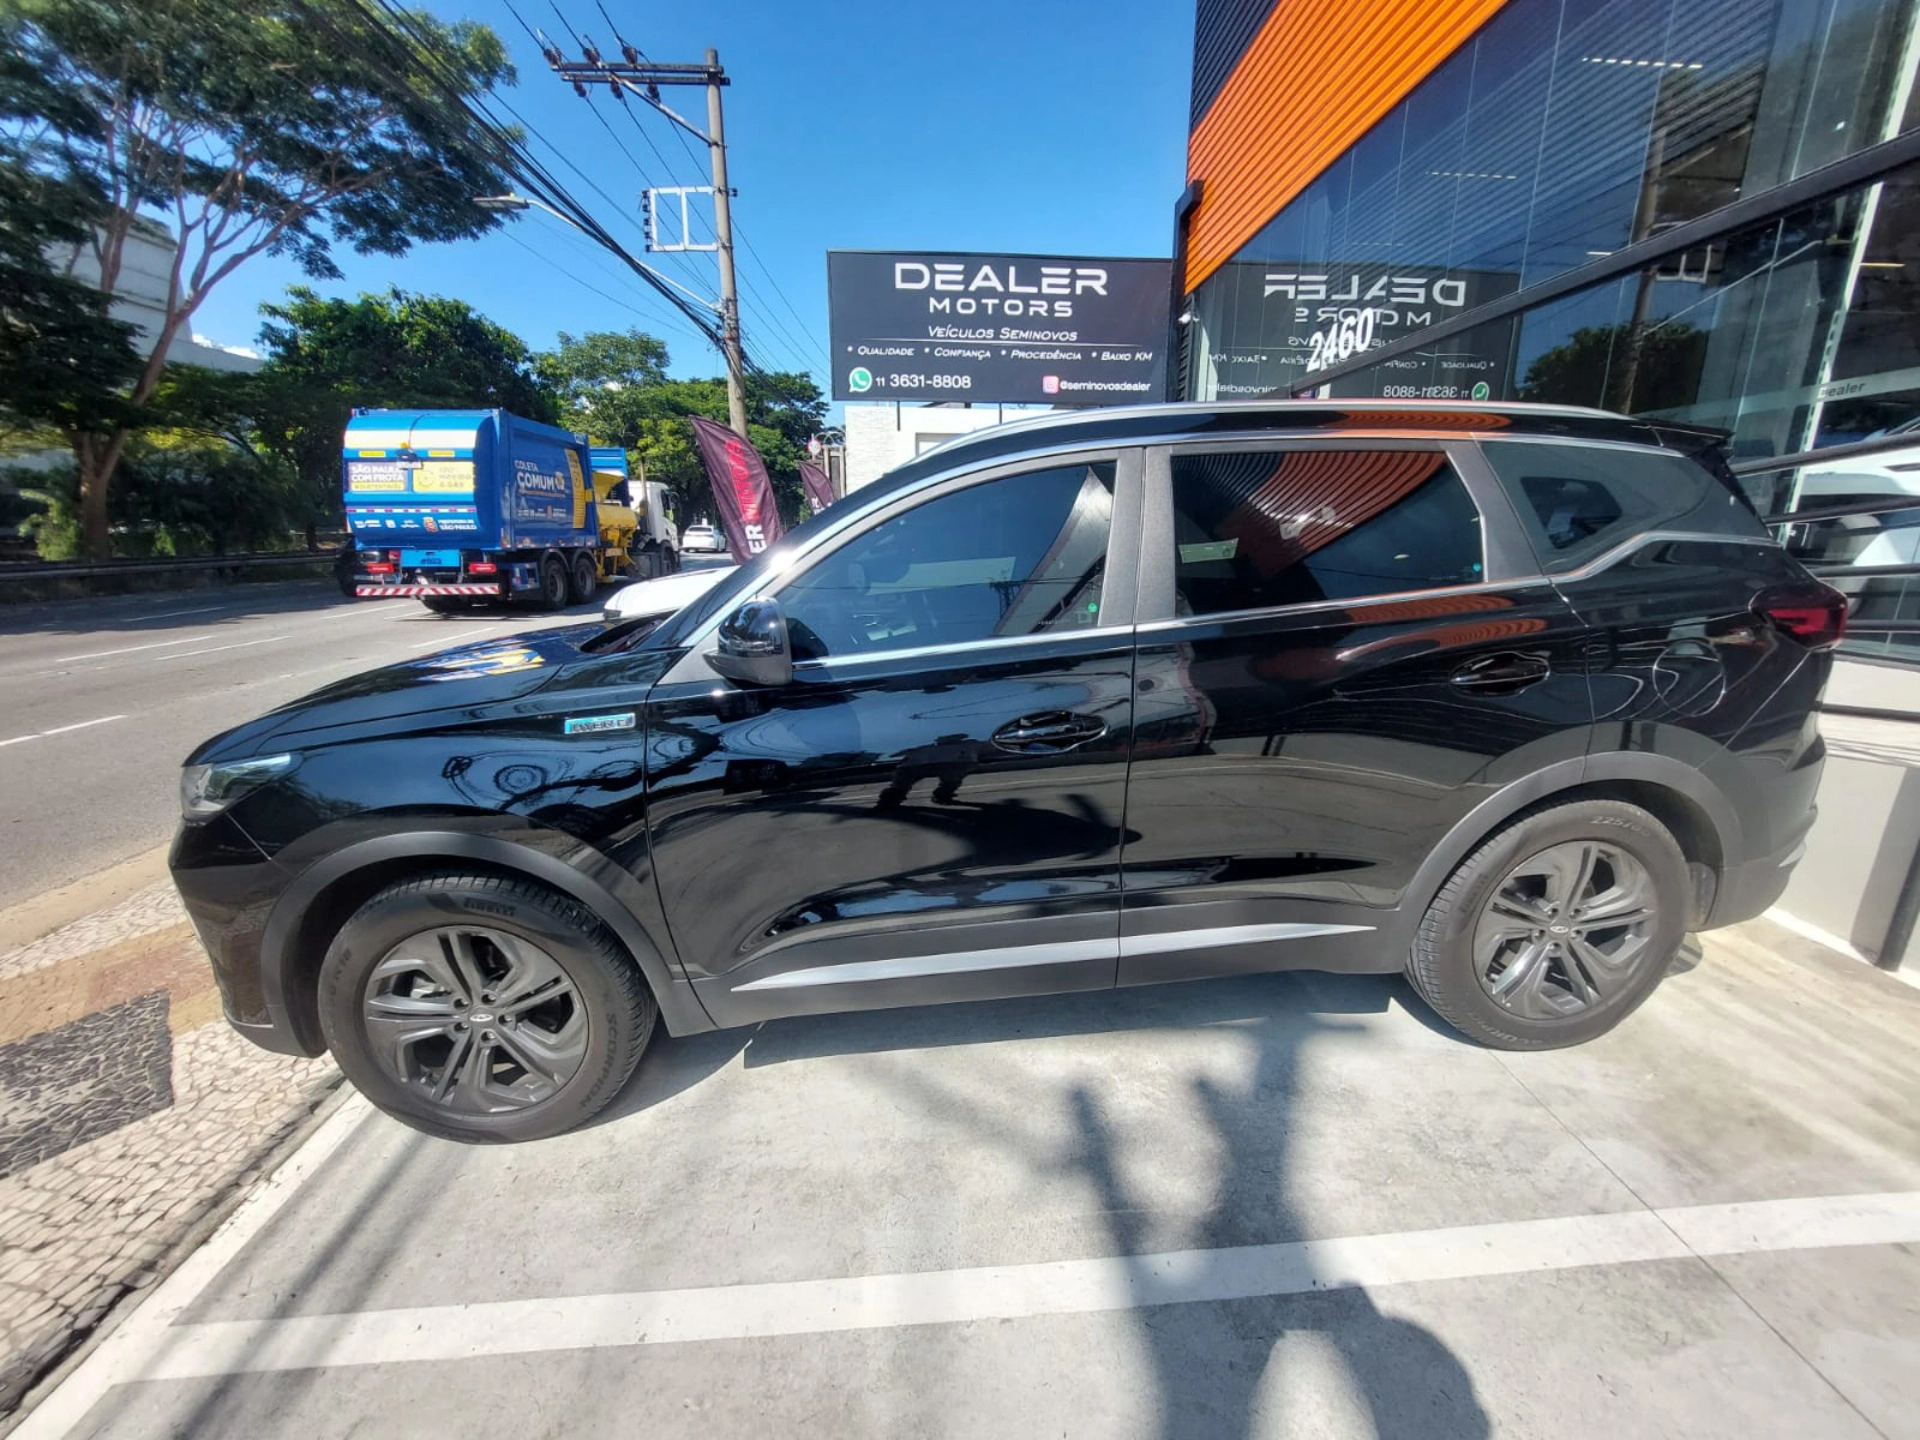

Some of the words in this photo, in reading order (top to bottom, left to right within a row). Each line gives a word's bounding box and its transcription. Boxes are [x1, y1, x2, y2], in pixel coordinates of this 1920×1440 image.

[894, 262, 1108, 295] DEALER
[929, 297, 1073, 317] MOTORS
[928, 324, 995, 339] VEÍCULOS
[1000, 327, 1078, 341] SEMINOVOS
[1306, 307, 1375, 373] 2460
[857, 346, 915, 356] QUALIDADE
[934, 347, 991, 360] CONFIANÇA
[1010, 349, 1082, 360] PROCEDÊNCIA
[1101, 351, 1131, 361] BAIXO
[1134, 352, 1153, 361] KM
[875, 376, 886, 387] 11
[889, 373, 972, 389] 3631-8808
[1059, 380, 1152, 392] @seminovosdealer
[514, 460, 539, 473] COLETA
[516, 471, 555, 491] COMUM
[580, 1012, 618, 1108] SCORPION
